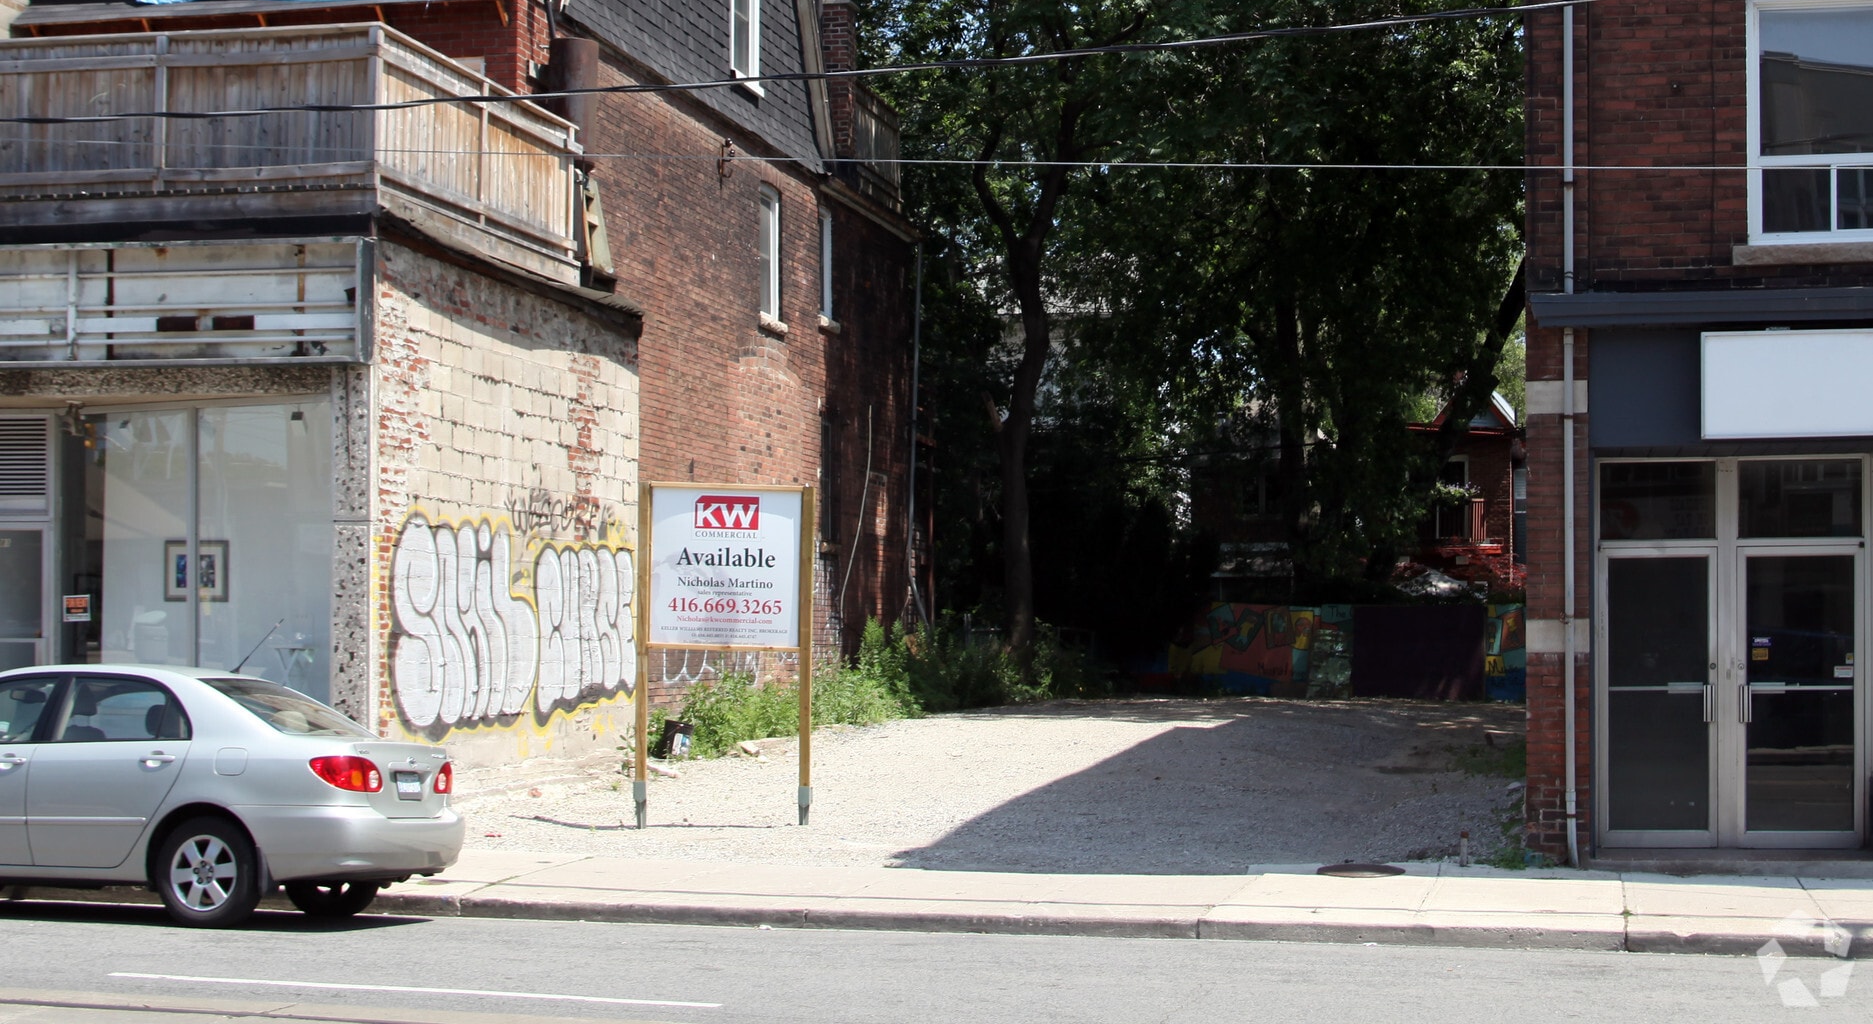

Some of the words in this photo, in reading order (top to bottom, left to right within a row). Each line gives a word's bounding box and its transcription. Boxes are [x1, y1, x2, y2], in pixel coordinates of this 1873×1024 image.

[695, 502, 758, 528] KW
[695, 530, 758, 539] COMMERCIAL
[676, 546, 776, 568] Available
[677, 576, 725, 587] Nicholas
[727, 578, 773, 589] Martino
[667, 596, 782, 615] 416.669.3265
